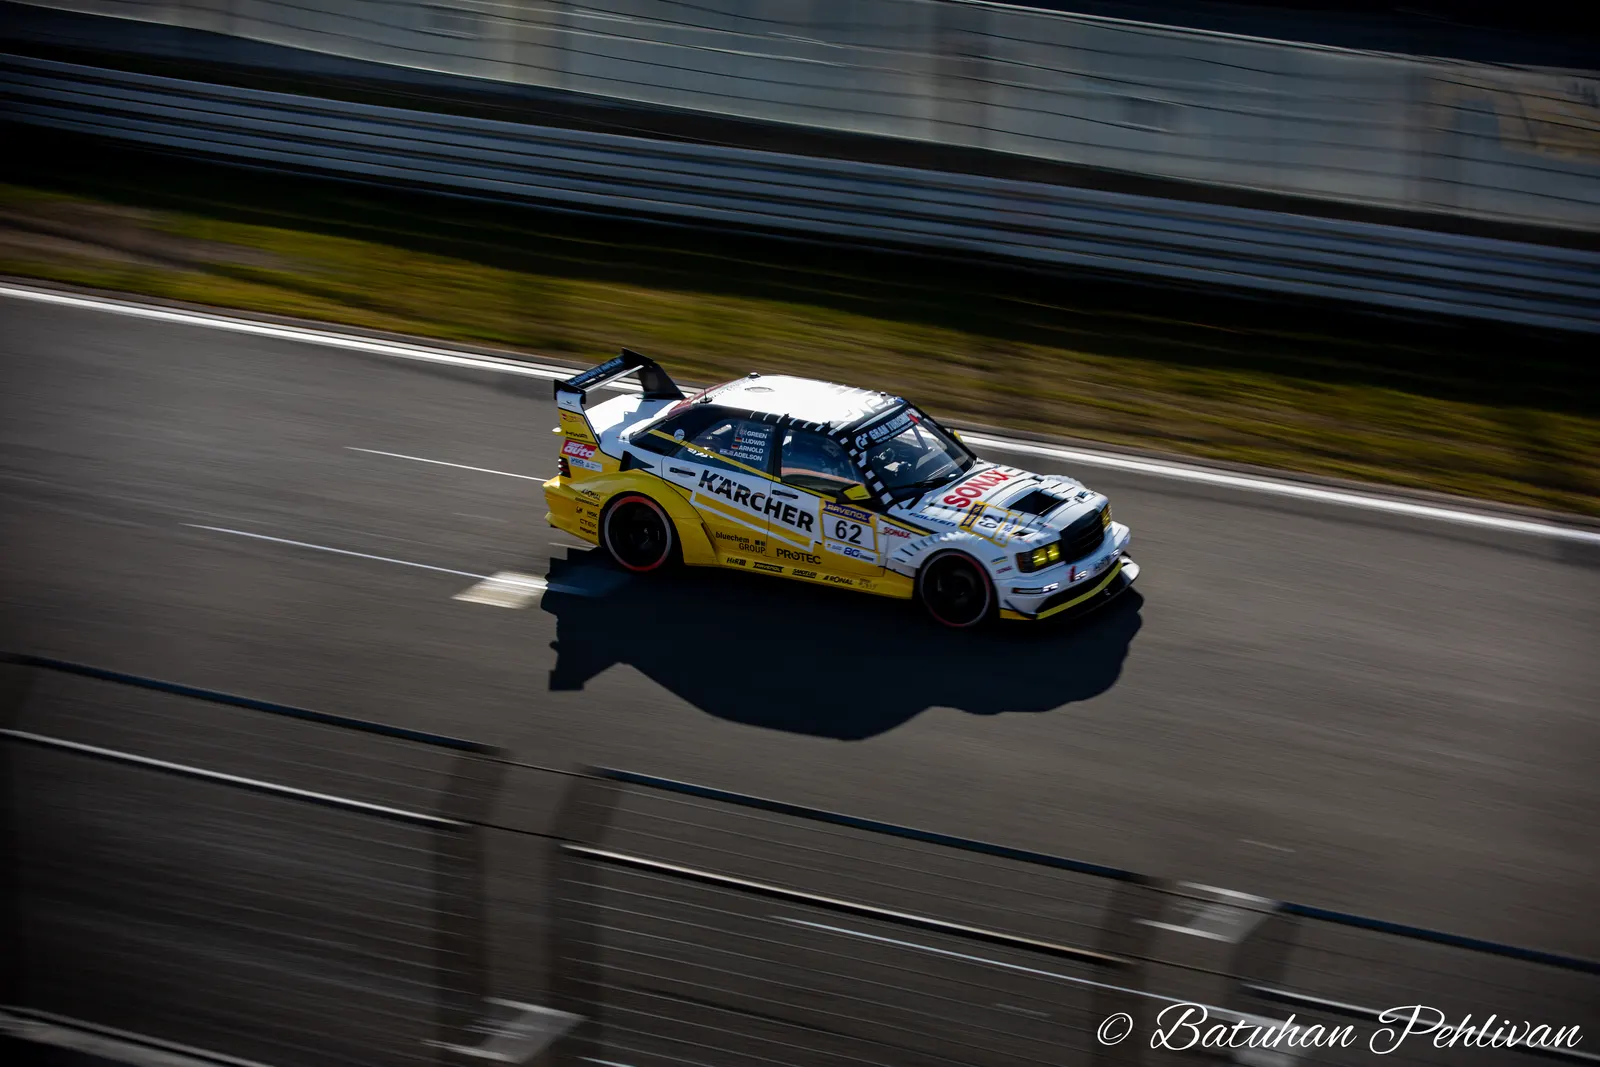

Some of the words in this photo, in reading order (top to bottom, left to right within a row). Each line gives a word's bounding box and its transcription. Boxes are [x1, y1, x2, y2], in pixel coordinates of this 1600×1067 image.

[746, 430, 767, 439] GREEN
[868, 424, 890, 441] GRAN
[741, 438, 765, 447] LUDWIG
[564, 445, 595, 458] auto
[733, 451, 762, 461] ADELSON
[738, 445, 764, 454] ARNOLD
[943, 469, 1010, 509] SONAX
[698, 469, 814, 533] KÄRCHER
[827, 504, 868, 520] RAVENOL
[715, 531, 750, 544] bluechem
[835, 520, 862, 545] 62
[883, 526, 911, 539] SONAX
[739, 542, 766, 555] GROUP
[776, 548, 822, 565] PROTEC
